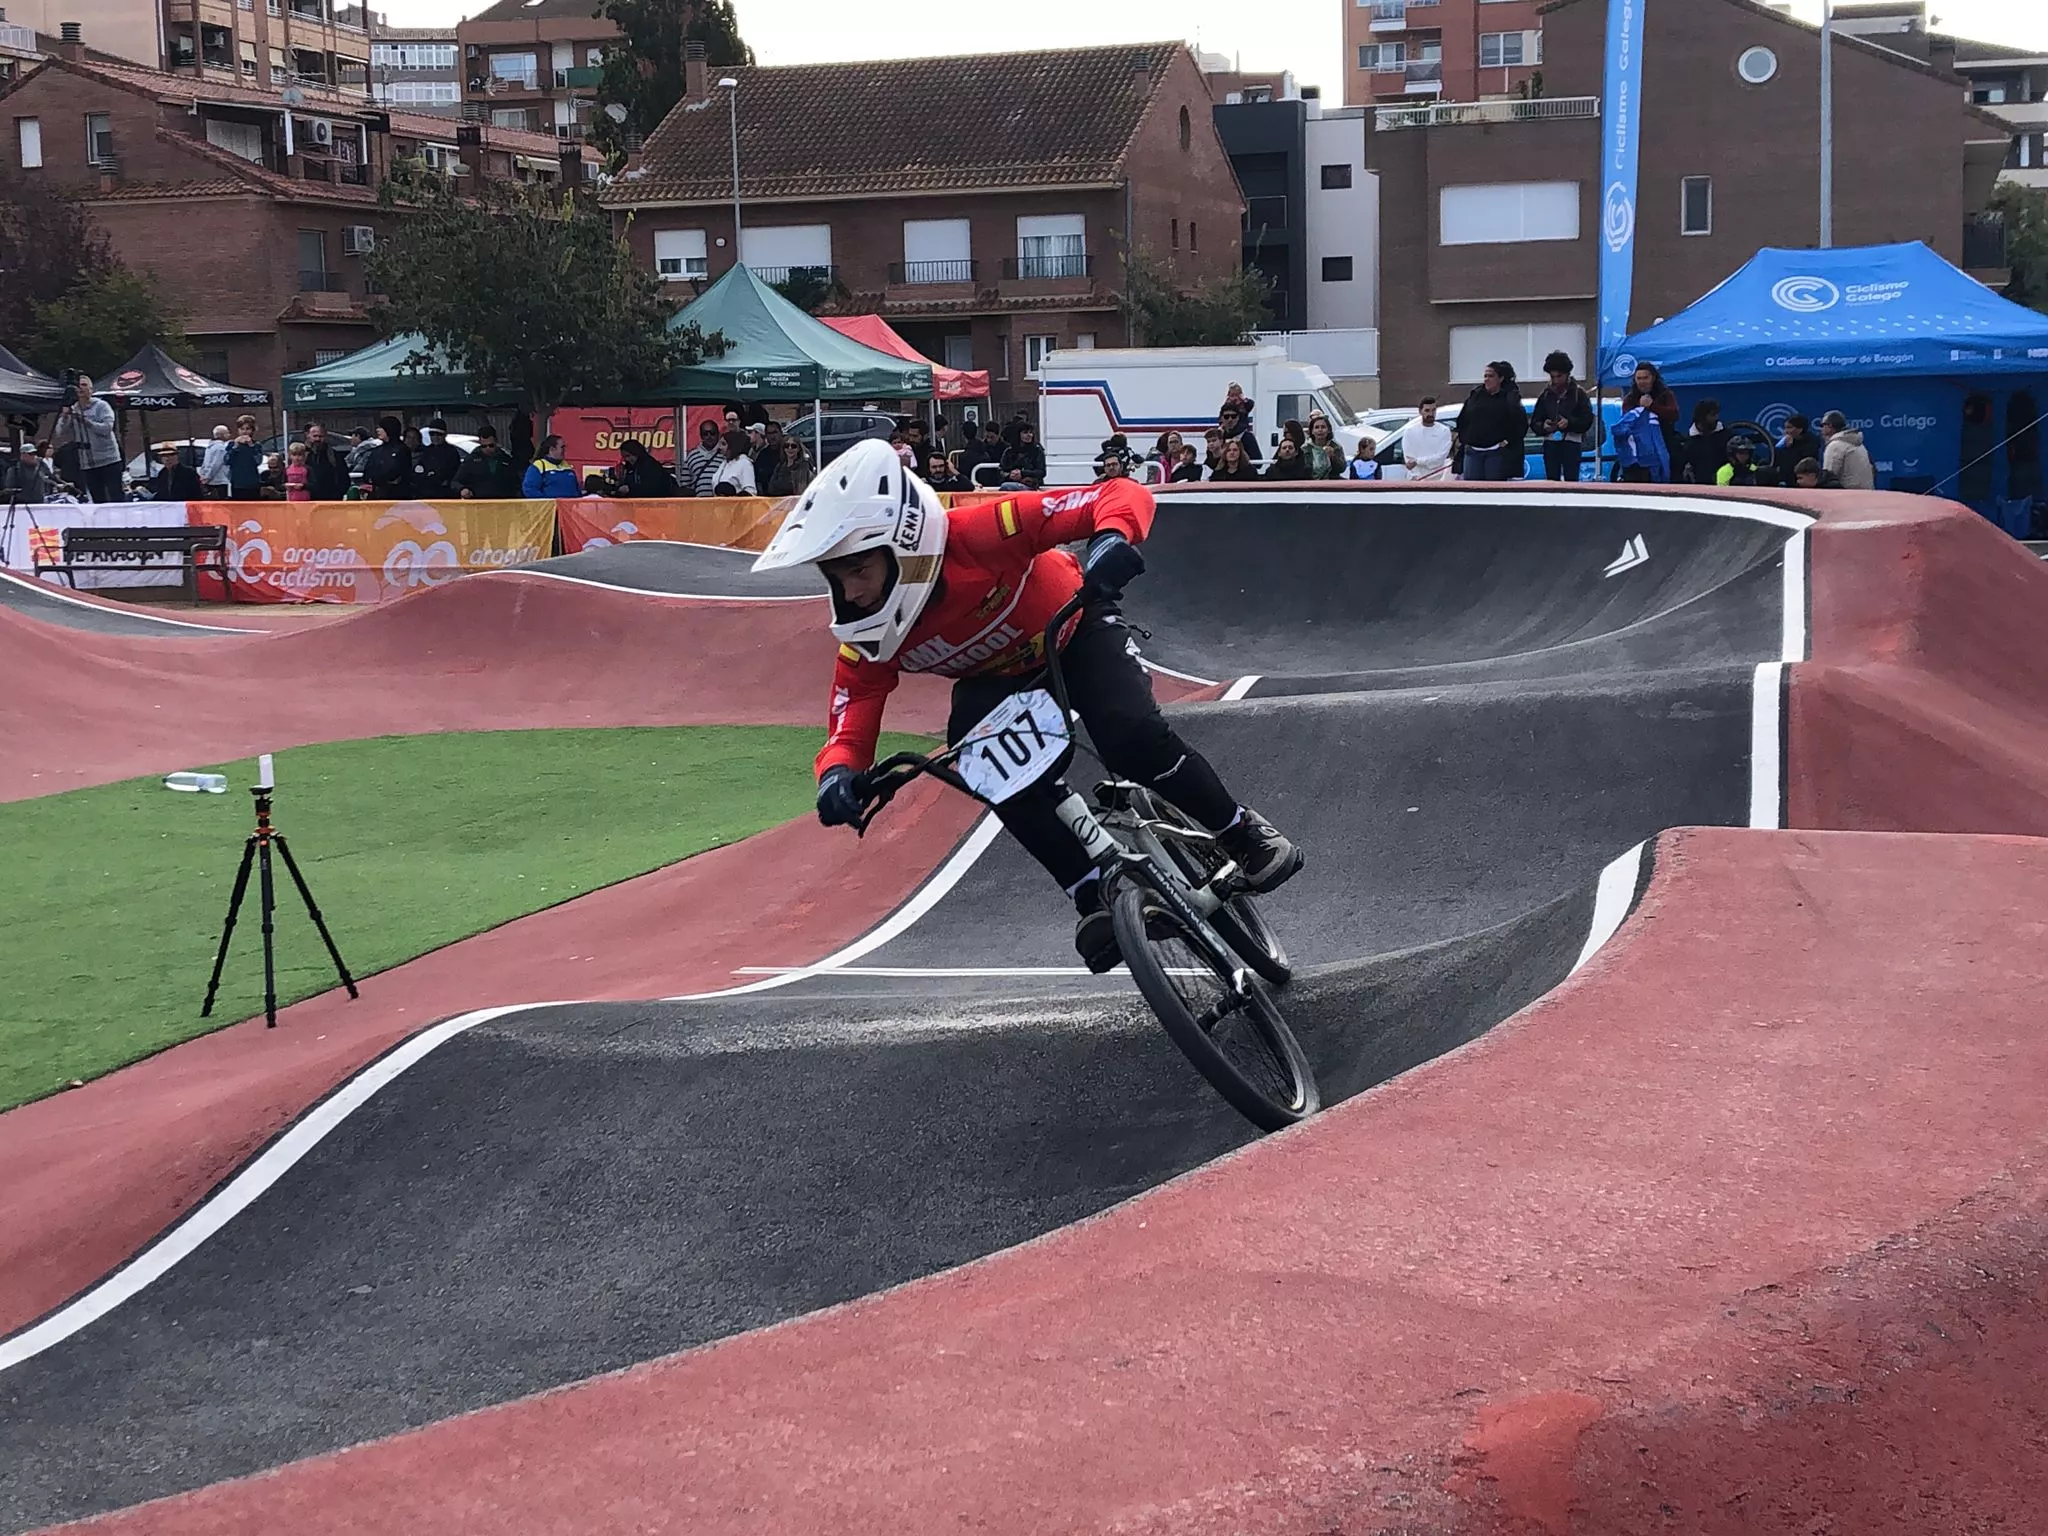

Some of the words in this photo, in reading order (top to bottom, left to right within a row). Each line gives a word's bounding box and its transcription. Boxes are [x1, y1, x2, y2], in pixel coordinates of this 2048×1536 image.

[1615, 80, 1628, 170] Ciclismo
[1845, 280, 1910, 294] Ciclismo
[1845, 290, 1902, 302] Galego
[1765, 357, 1775, 367] O
[130, 396, 176, 407] 24MX
[1880, 413, 1937, 430] Galego
[283, 543, 356, 567] aragón
[268, 565, 356, 587] ciclismo
[980, 708, 1047, 781] 107
